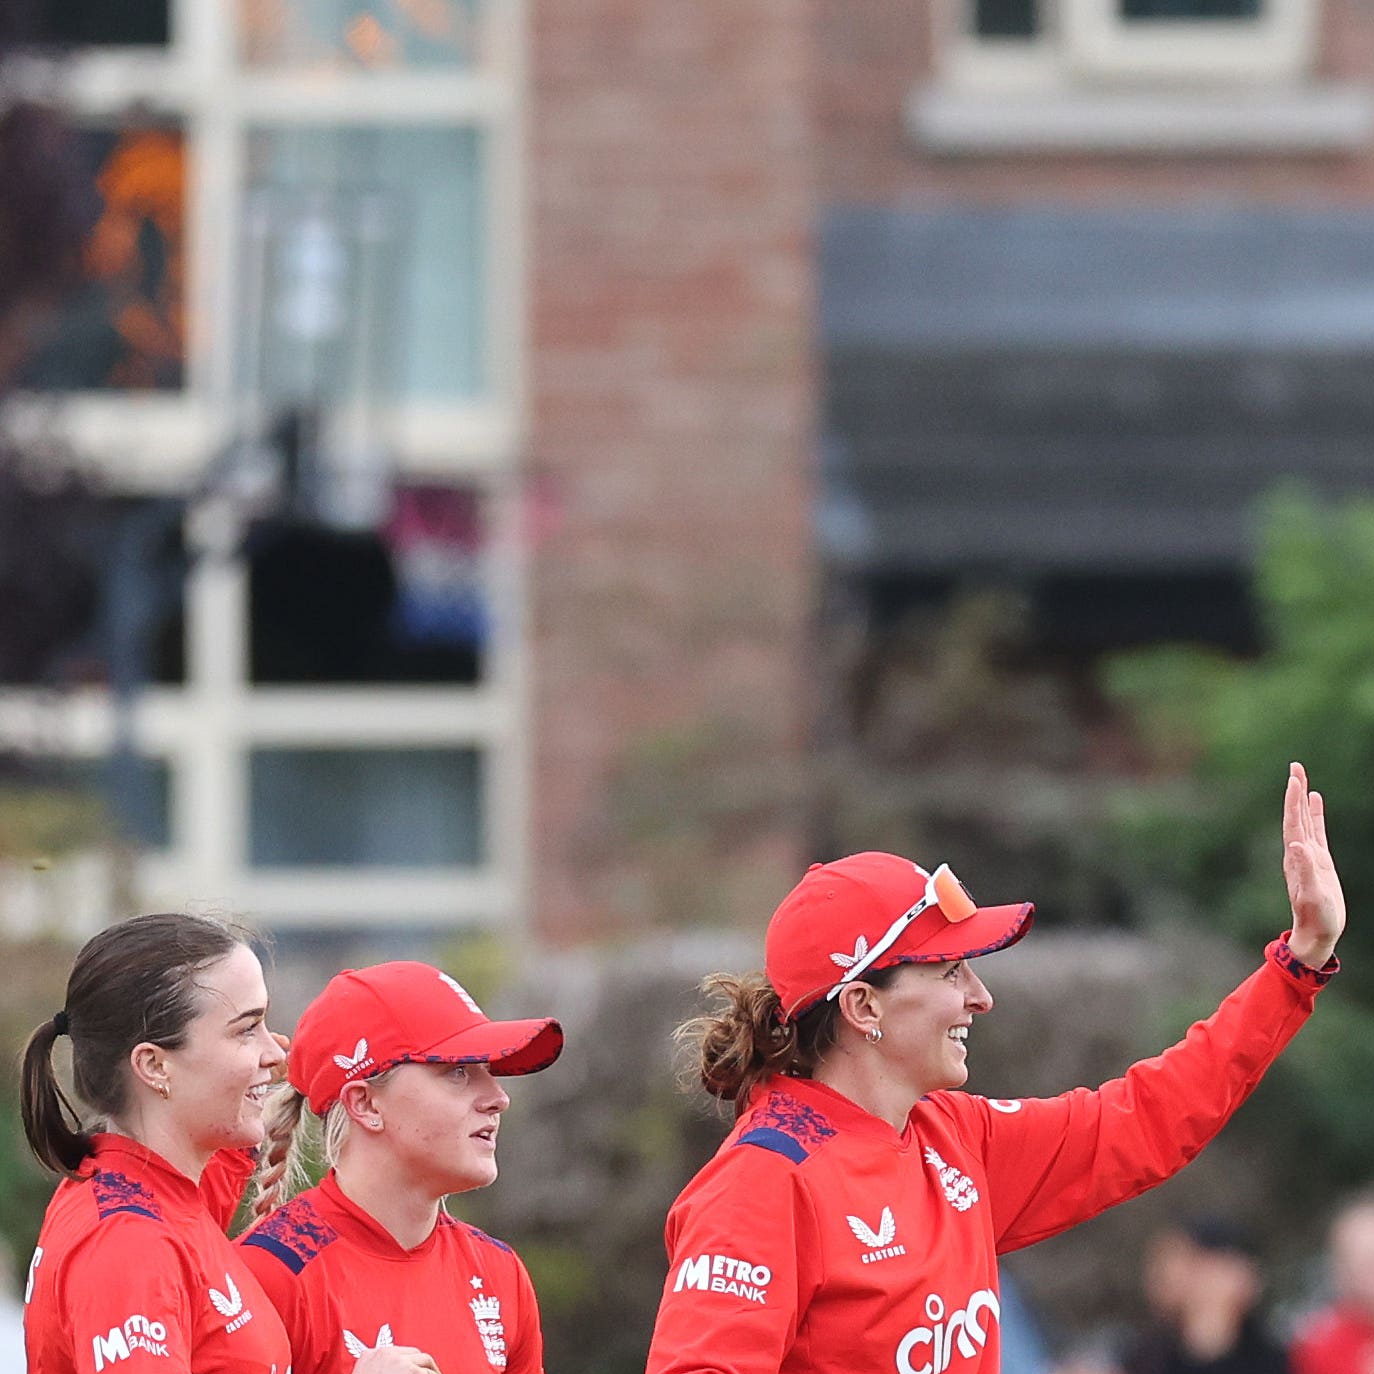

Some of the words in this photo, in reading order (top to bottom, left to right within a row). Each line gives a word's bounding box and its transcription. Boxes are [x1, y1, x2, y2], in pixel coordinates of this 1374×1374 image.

[861, 1244, 907, 1265] CASTORE
[672, 1254, 772, 1293] METRO
[710, 1277, 767, 1305] BANK
[92, 1313, 168, 1373] METRO
[128, 1335, 171, 1358] BANK
